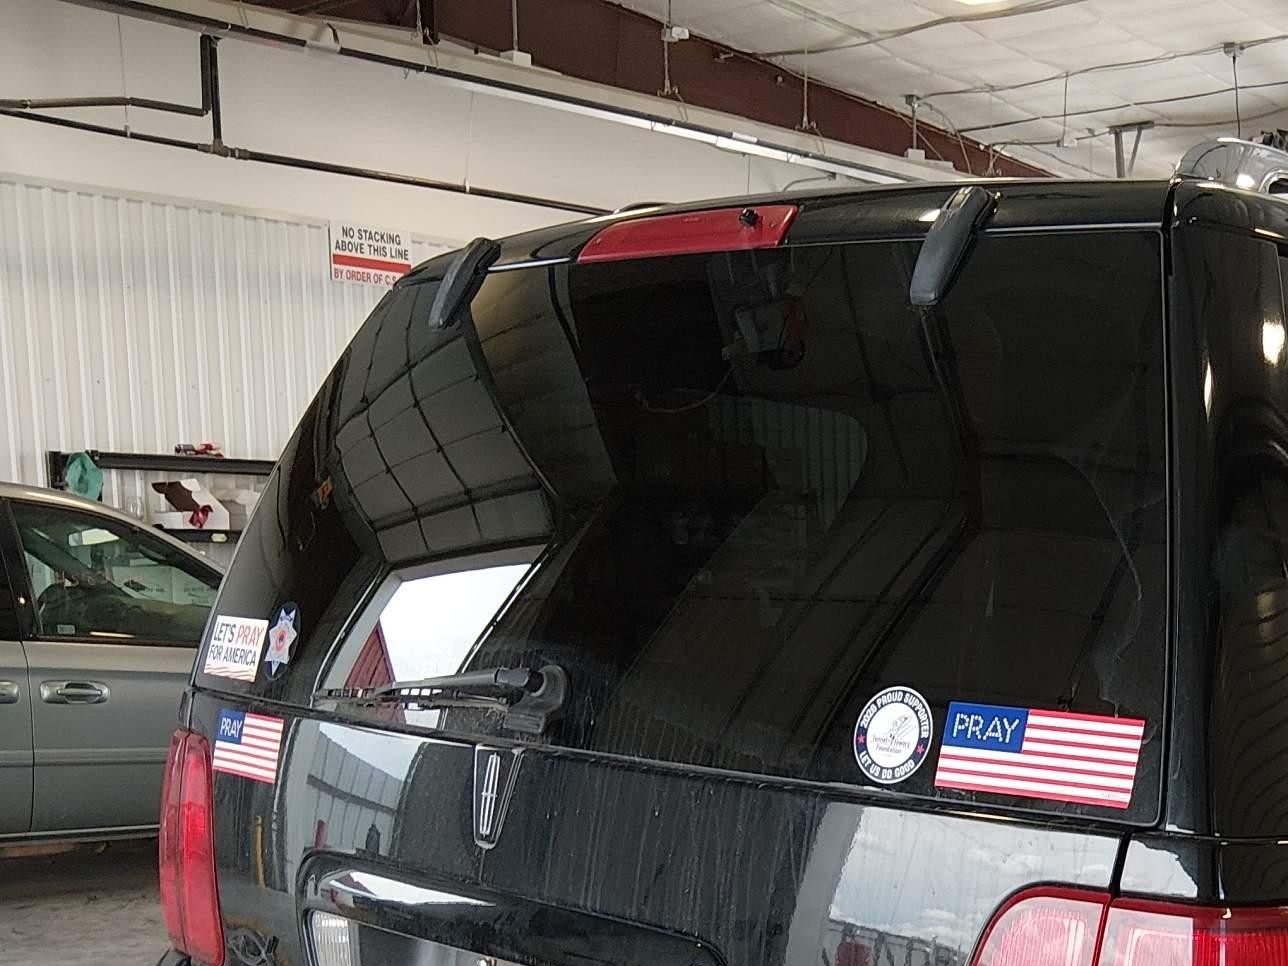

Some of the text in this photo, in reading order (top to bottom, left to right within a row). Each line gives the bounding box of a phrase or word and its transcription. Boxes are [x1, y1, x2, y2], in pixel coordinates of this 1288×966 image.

[342, 226, 401, 245] NO STACKING
[335, 240, 409, 260] ABOVE THIS LINE
[334, 268, 344, 280] BY
[346, 270, 372, 282] ORDER
[374, 272, 383, 284] OF
[214, 622, 264, 648] LET'S PRAY
[208, 644, 257, 667] FOR AMERICA
[876, 691, 904, 708] PROUD
[904, 692, 930, 739] SUPPORTER
[220, 717, 243, 738] PRAY
[953, 712, 1020, 744] PRAY
[860, 750, 915, 779] LET US DO GOOD
